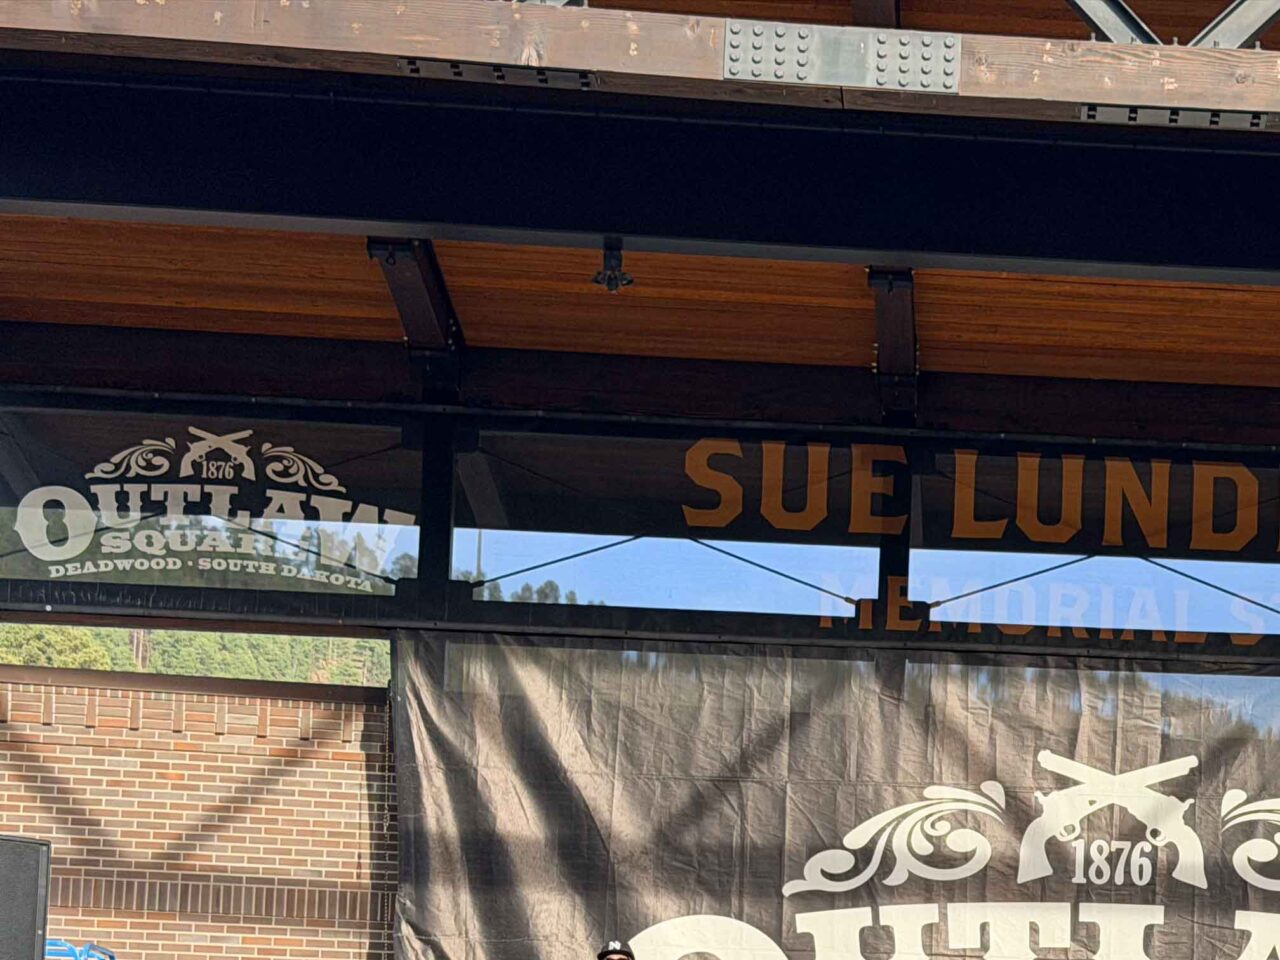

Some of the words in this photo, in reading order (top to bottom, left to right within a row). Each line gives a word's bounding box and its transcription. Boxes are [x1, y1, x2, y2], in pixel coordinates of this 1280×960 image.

[201, 460, 234, 479] 1876
[681, 437, 909, 535] SUE
[13, 484, 416, 574] OUTLAW
[100, 530, 311, 558] SQUARE
[49, 557, 182, 578] DEADWOOD
[198, 558, 276, 576] SOUTH
[282, 566, 373, 592] DAKOTA
[820, 575, 1208, 644] MEMORIAL
[1071, 837, 1153, 887] 1876
